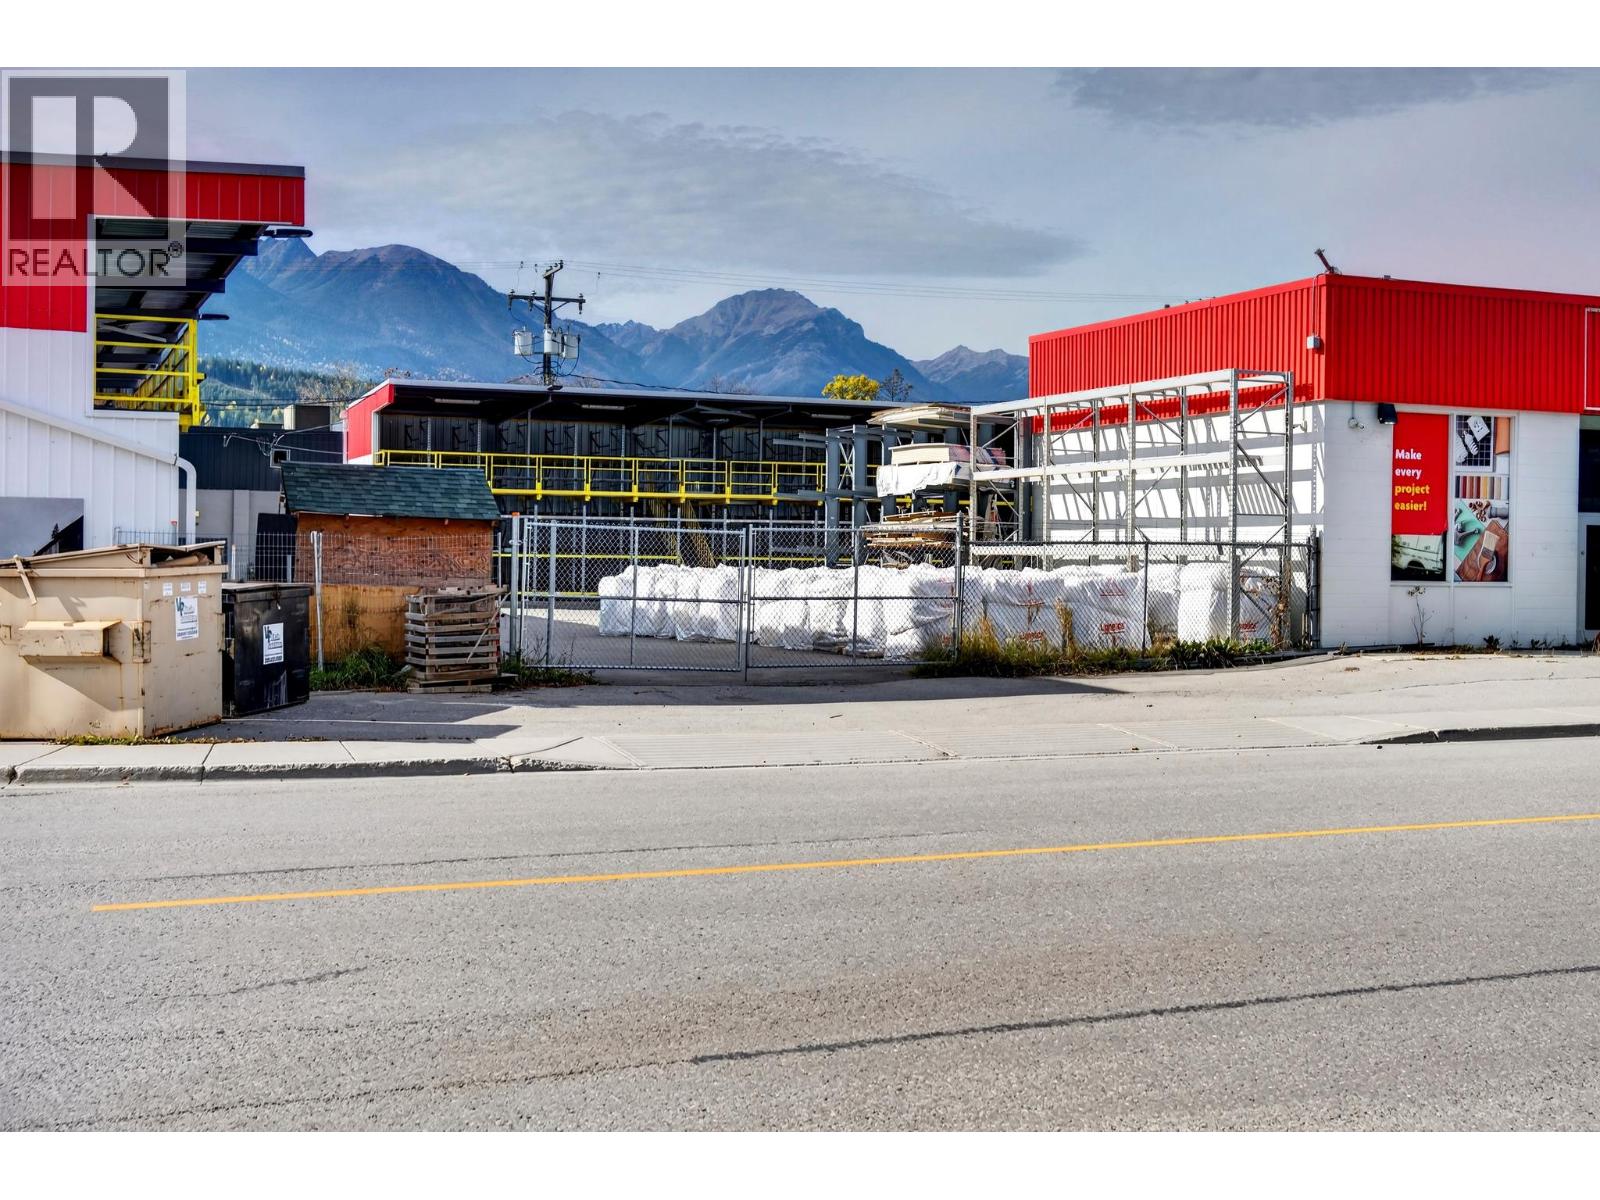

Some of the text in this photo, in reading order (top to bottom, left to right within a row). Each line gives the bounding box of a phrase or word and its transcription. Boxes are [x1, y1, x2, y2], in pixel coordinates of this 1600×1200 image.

[1395, 448, 1422, 460] Make
[1395, 468, 1422, 480] every
[1394, 482, 1430, 496] project
[1394, 499, 1427, 511] easier!
